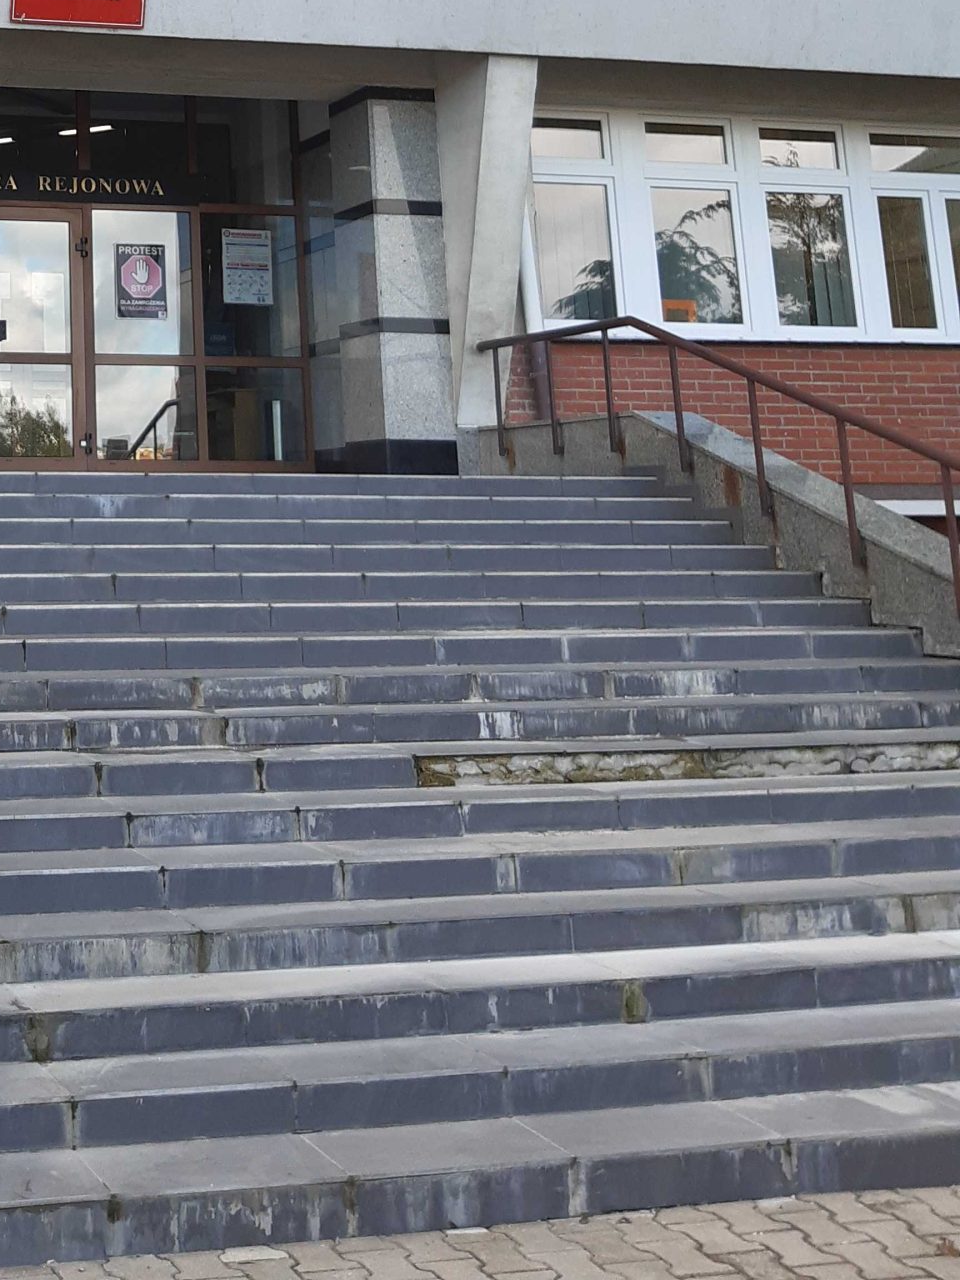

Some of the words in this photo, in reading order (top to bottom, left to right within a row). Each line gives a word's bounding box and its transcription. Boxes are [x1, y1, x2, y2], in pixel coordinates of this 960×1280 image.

[38, 175, 164, 196] REJONOWA
[118, 246, 163, 255] PROTEST
[131, 284, 153, 292] STOP
